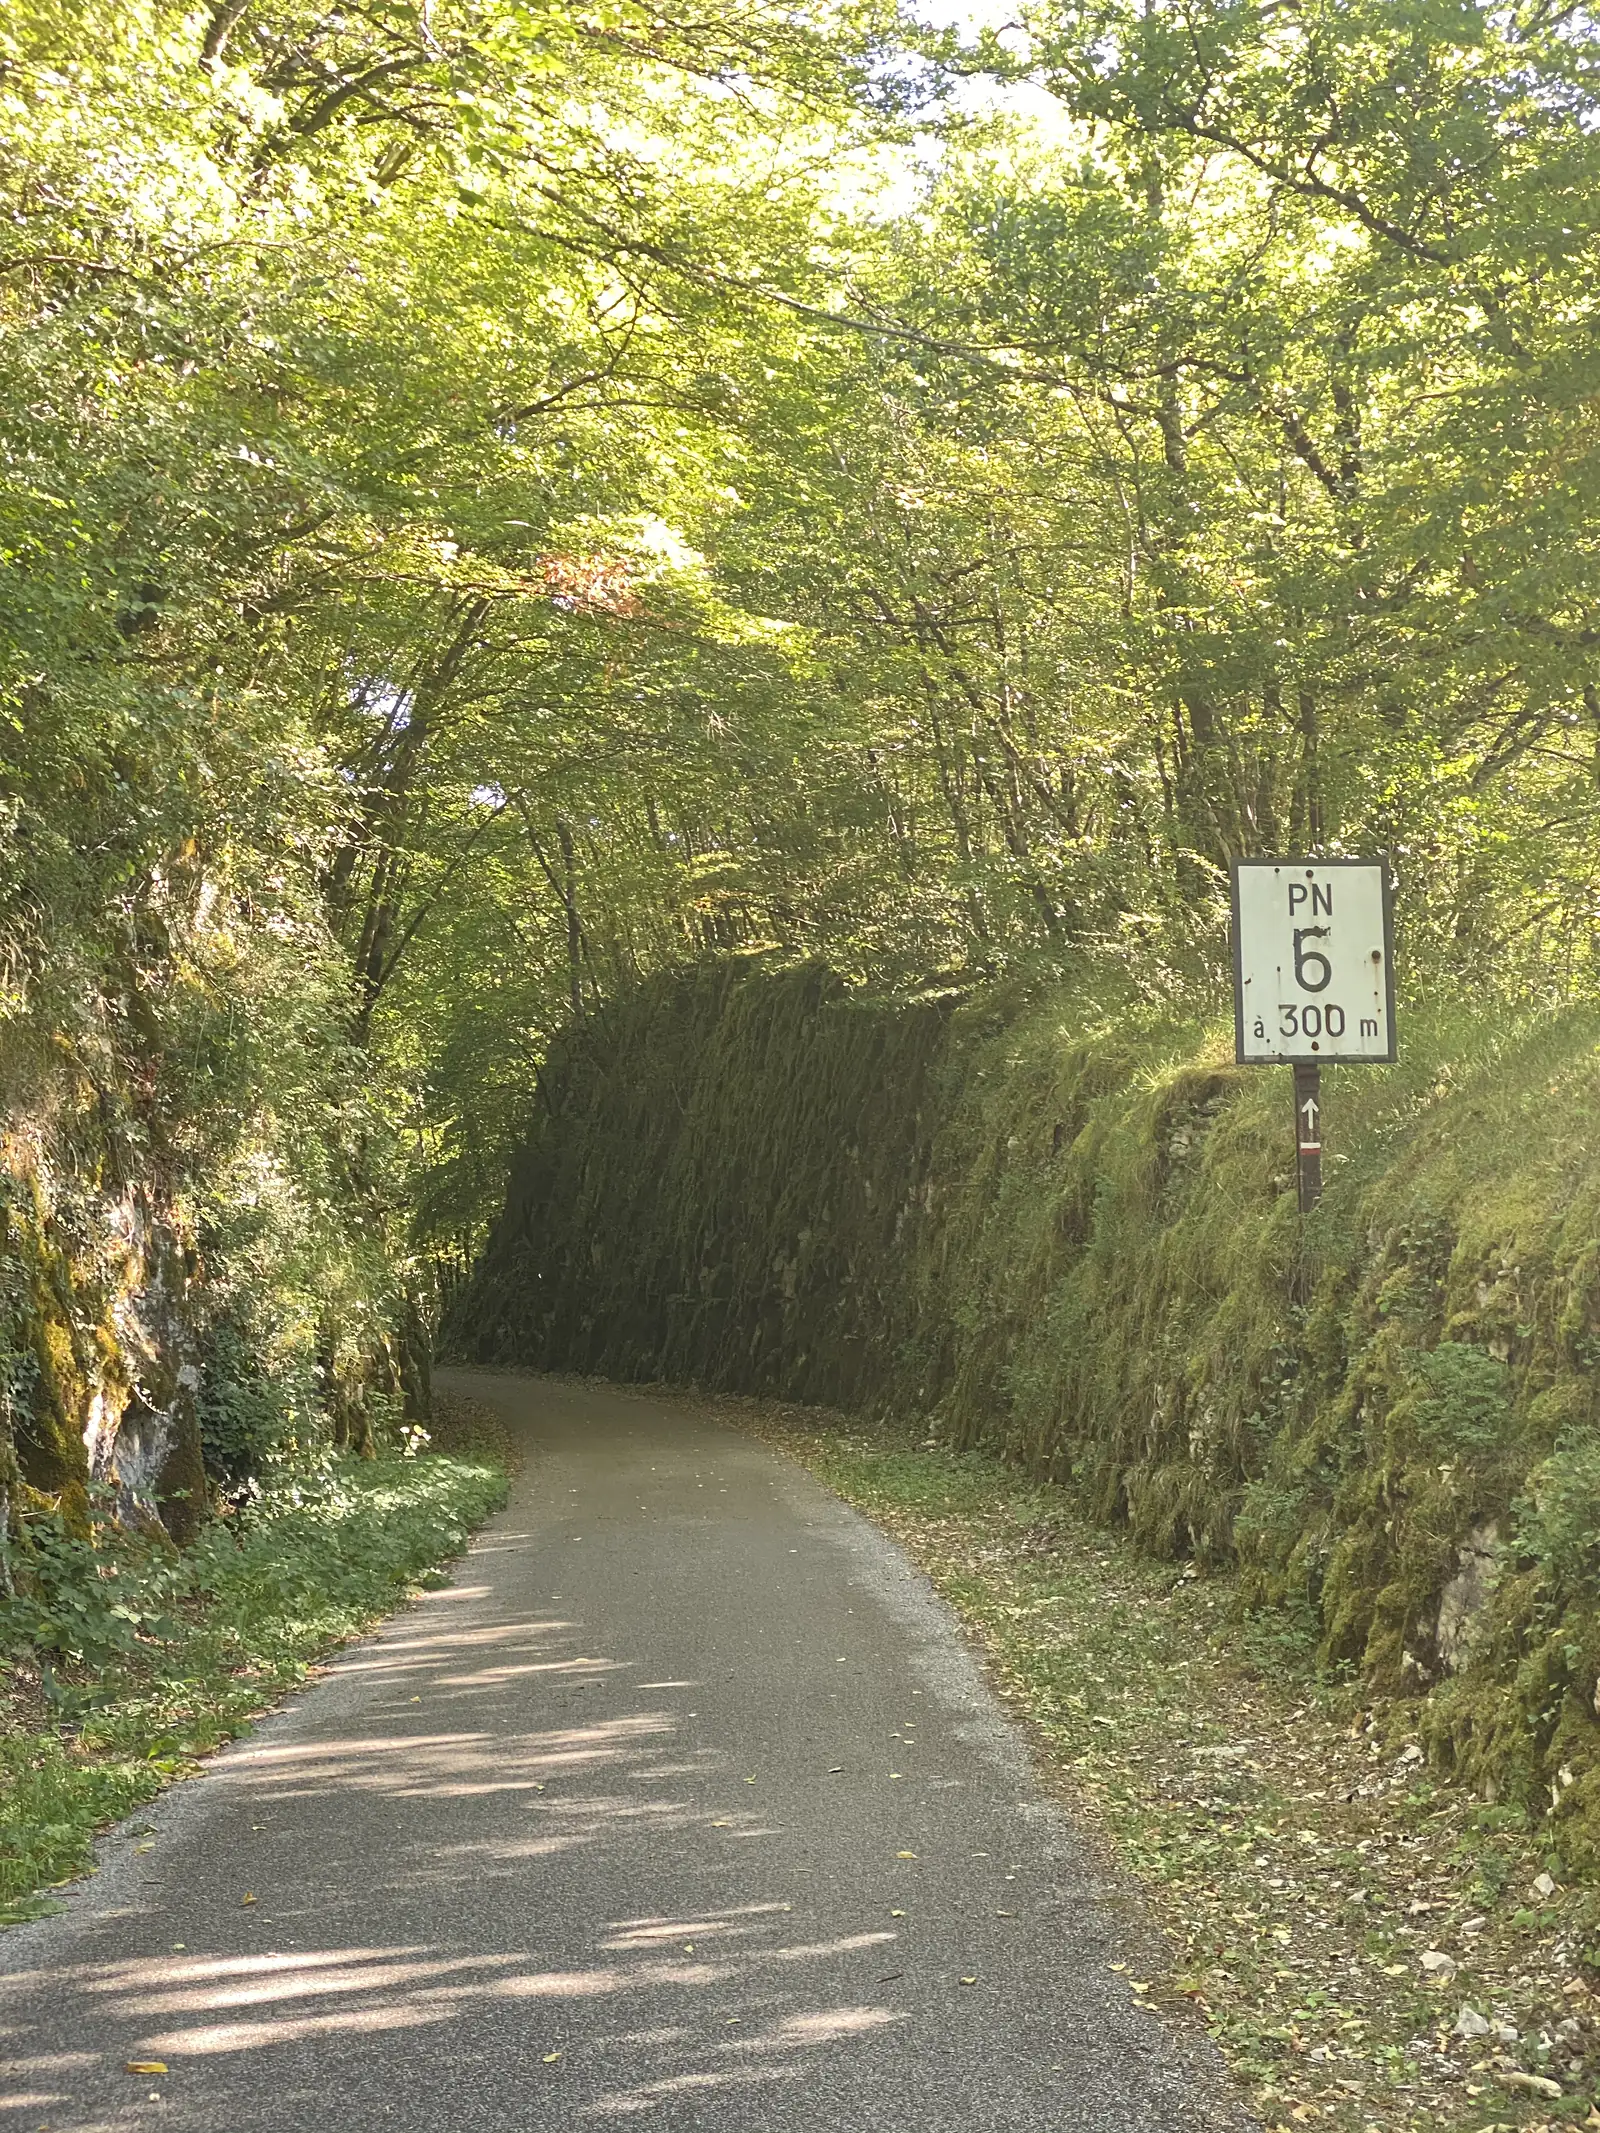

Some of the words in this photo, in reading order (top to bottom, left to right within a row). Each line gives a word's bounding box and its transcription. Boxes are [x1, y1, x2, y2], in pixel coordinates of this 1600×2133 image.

[1288, 883, 1333, 917] PN
[1293, 926, 1332, 993] 6
[1253, 1014, 1265, 1039] à
[1278, 1003, 1346, 1038] 300
[1360, 1018, 1378, 1037] m
